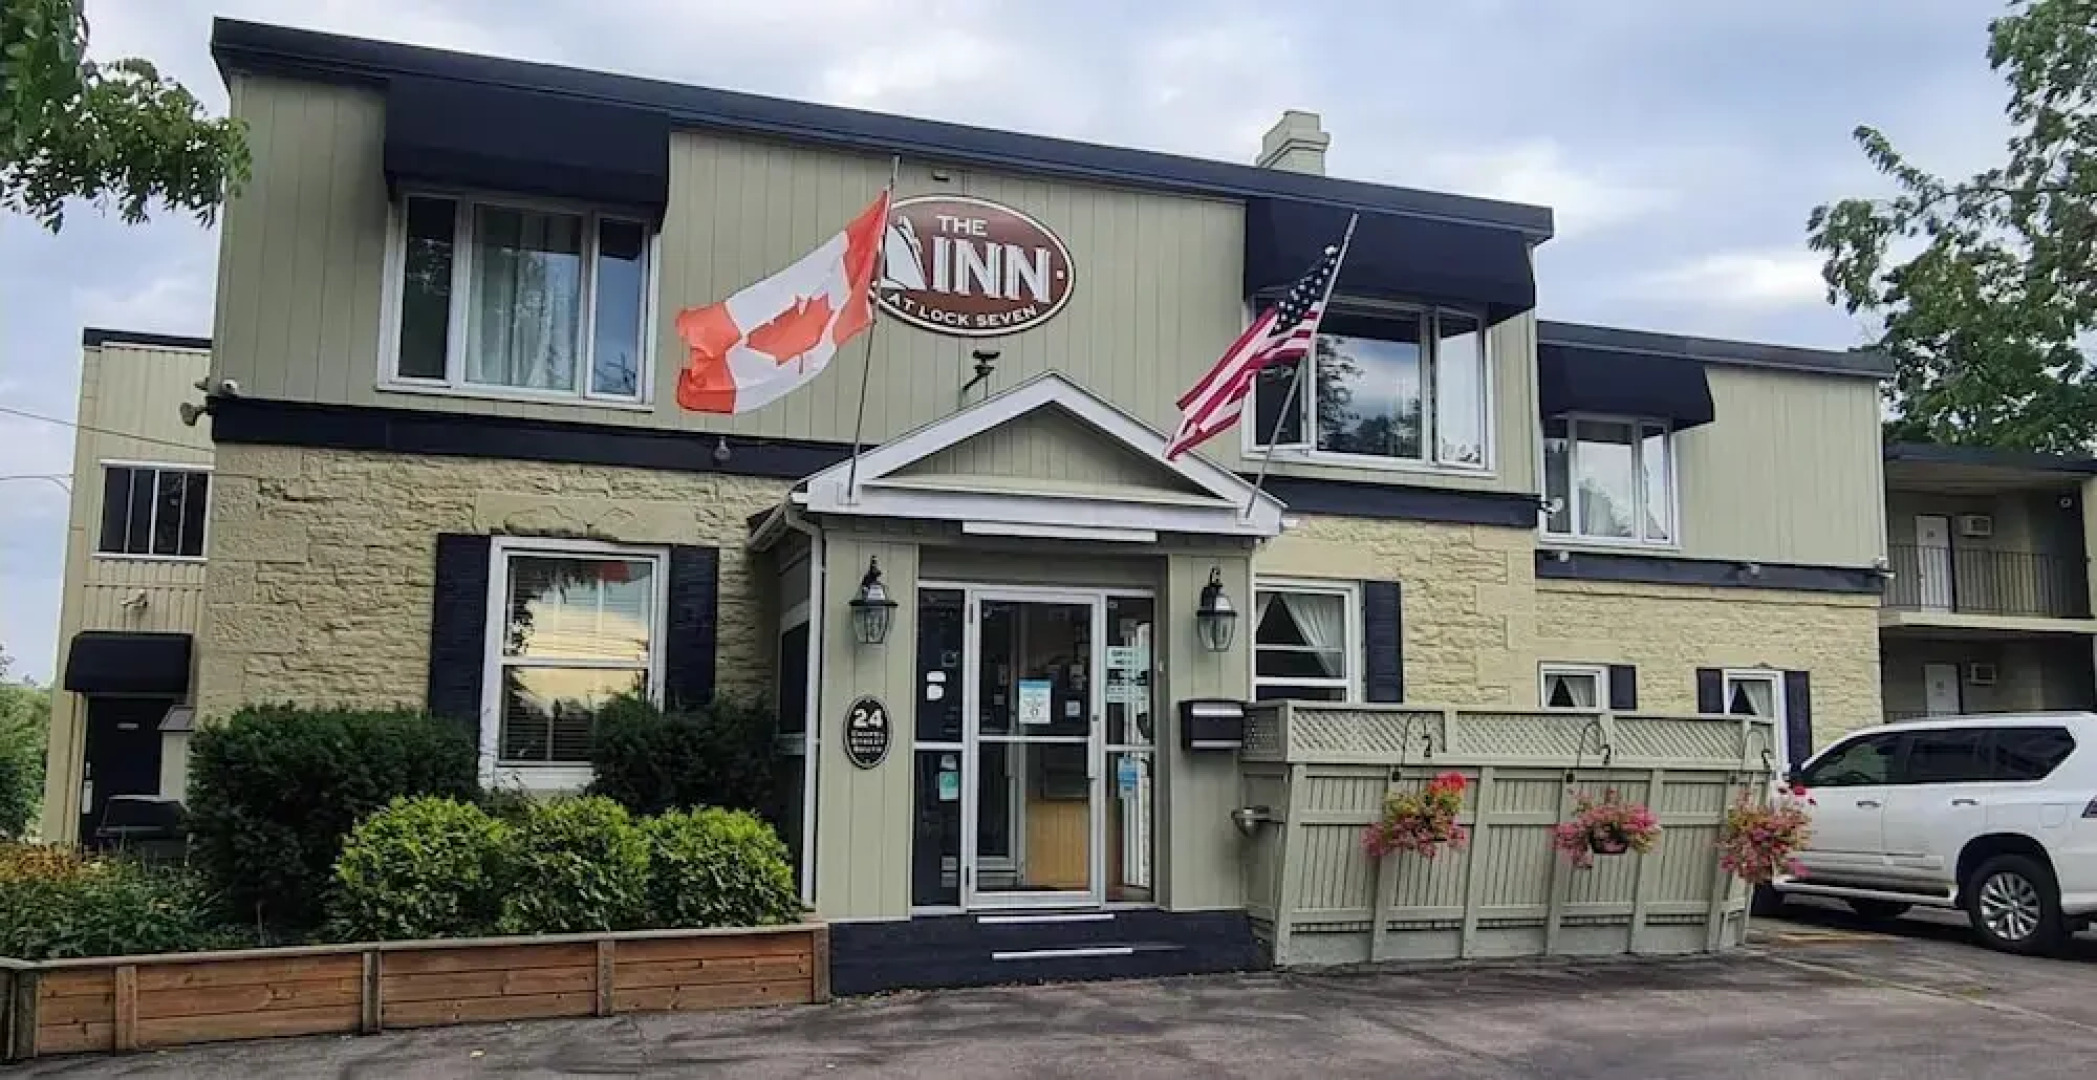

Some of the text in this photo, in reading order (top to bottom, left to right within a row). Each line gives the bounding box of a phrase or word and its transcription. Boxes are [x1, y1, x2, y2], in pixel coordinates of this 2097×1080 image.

[936, 215, 988, 236] THE
[932, 236, 1051, 303] INN
[888, 293, 1037, 327] AT LOCK SEVEN
[853, 708, 882, 728] 24
